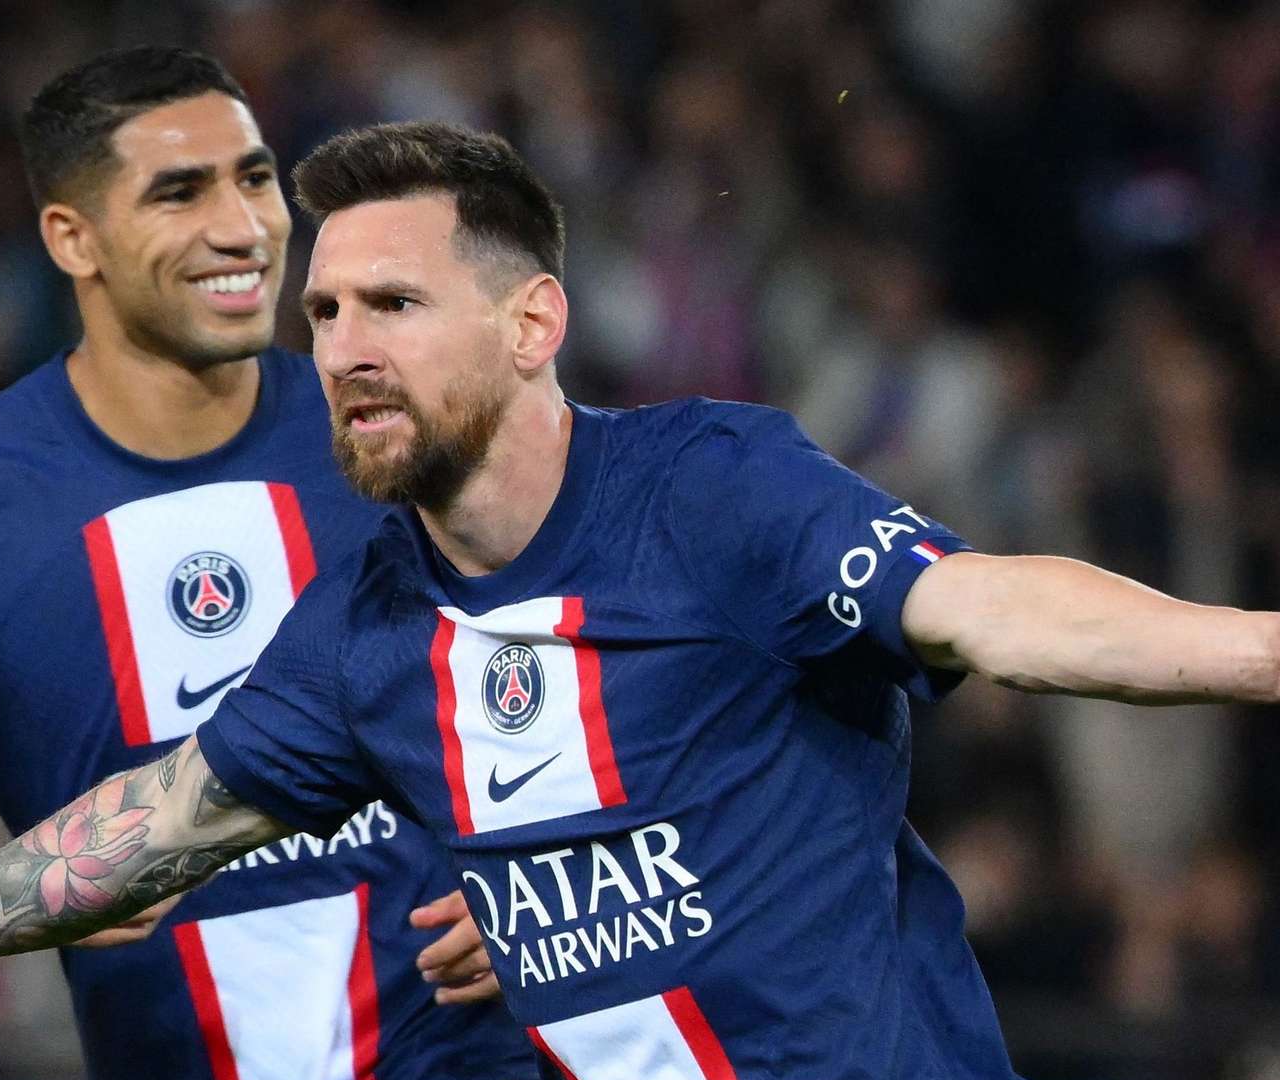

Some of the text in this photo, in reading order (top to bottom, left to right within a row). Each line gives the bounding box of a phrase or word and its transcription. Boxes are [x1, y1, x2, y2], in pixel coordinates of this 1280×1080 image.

[176, 556, 232, 582] PARIS
[827, 505, 930, 629] GOAT
[492, 649, 532, 675] PARIS
[217, 799, 397, 872] WAYS
[462, 821, 701, 956] QATAR
[520, 890, 713, 988] AIRWAYS
